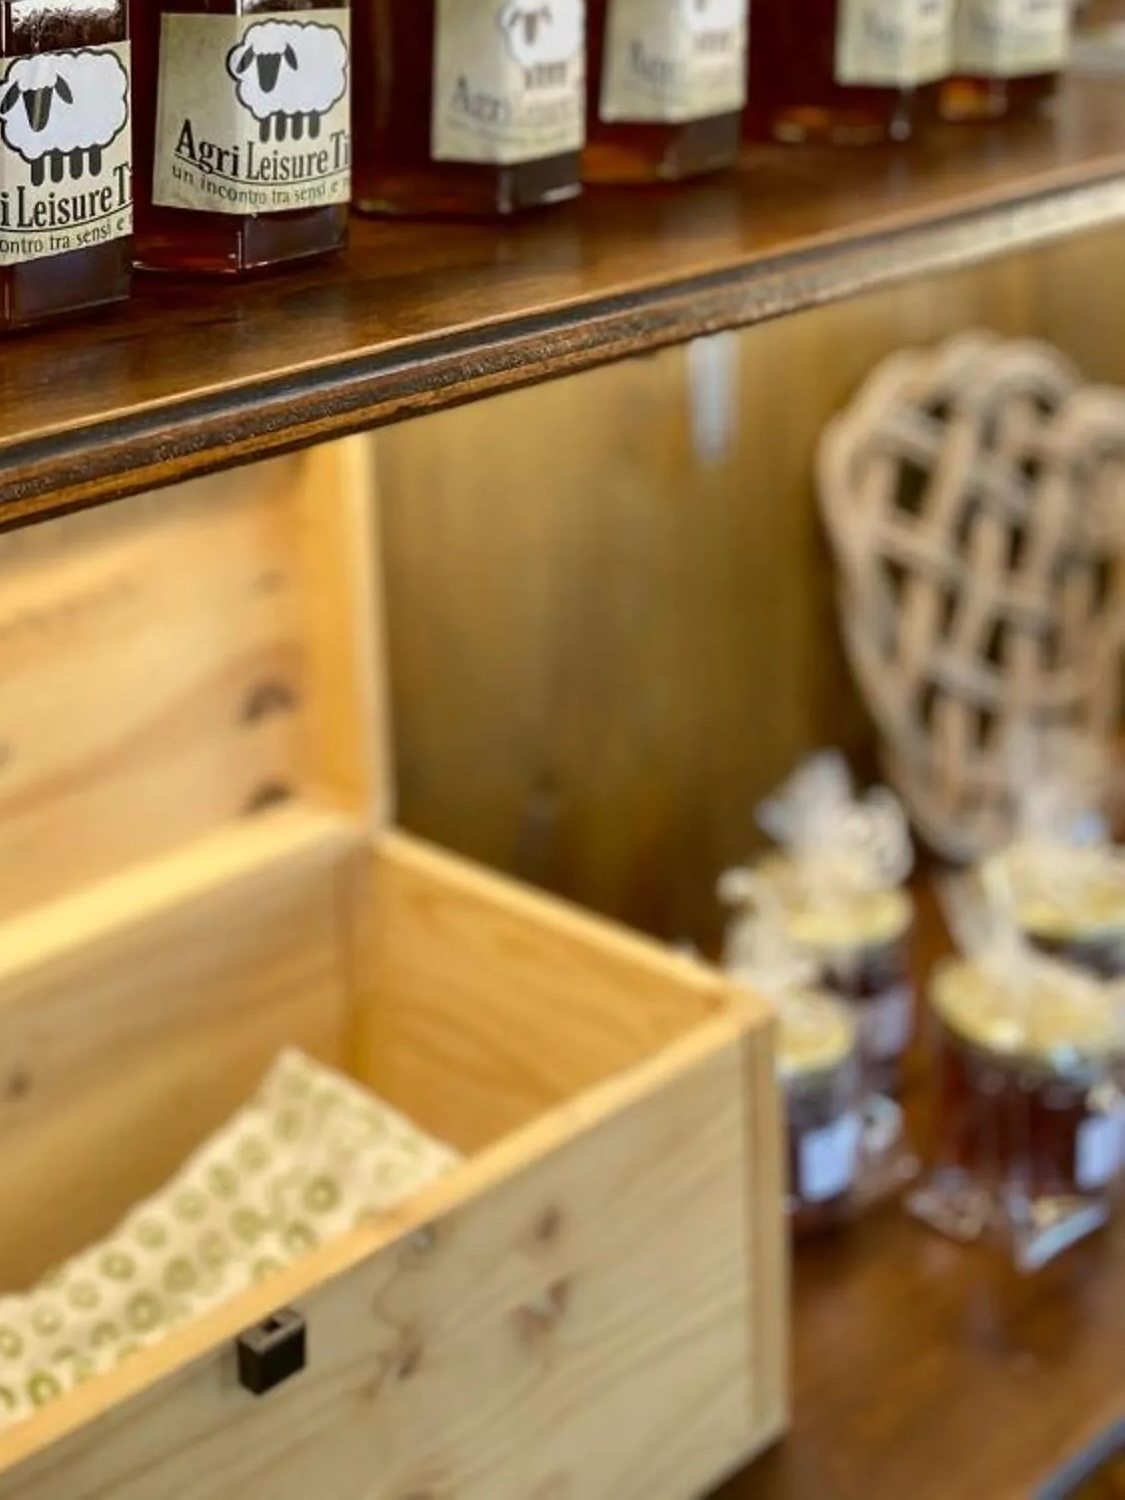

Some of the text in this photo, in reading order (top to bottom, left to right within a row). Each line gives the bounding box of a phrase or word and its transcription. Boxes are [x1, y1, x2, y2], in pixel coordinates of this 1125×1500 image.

[174, 117, 240, 177] Agri
[246, 140, 329, 181] Leisure
[16, 186, 113, 228] Leisure
[49, 233, 71, 250] tra
